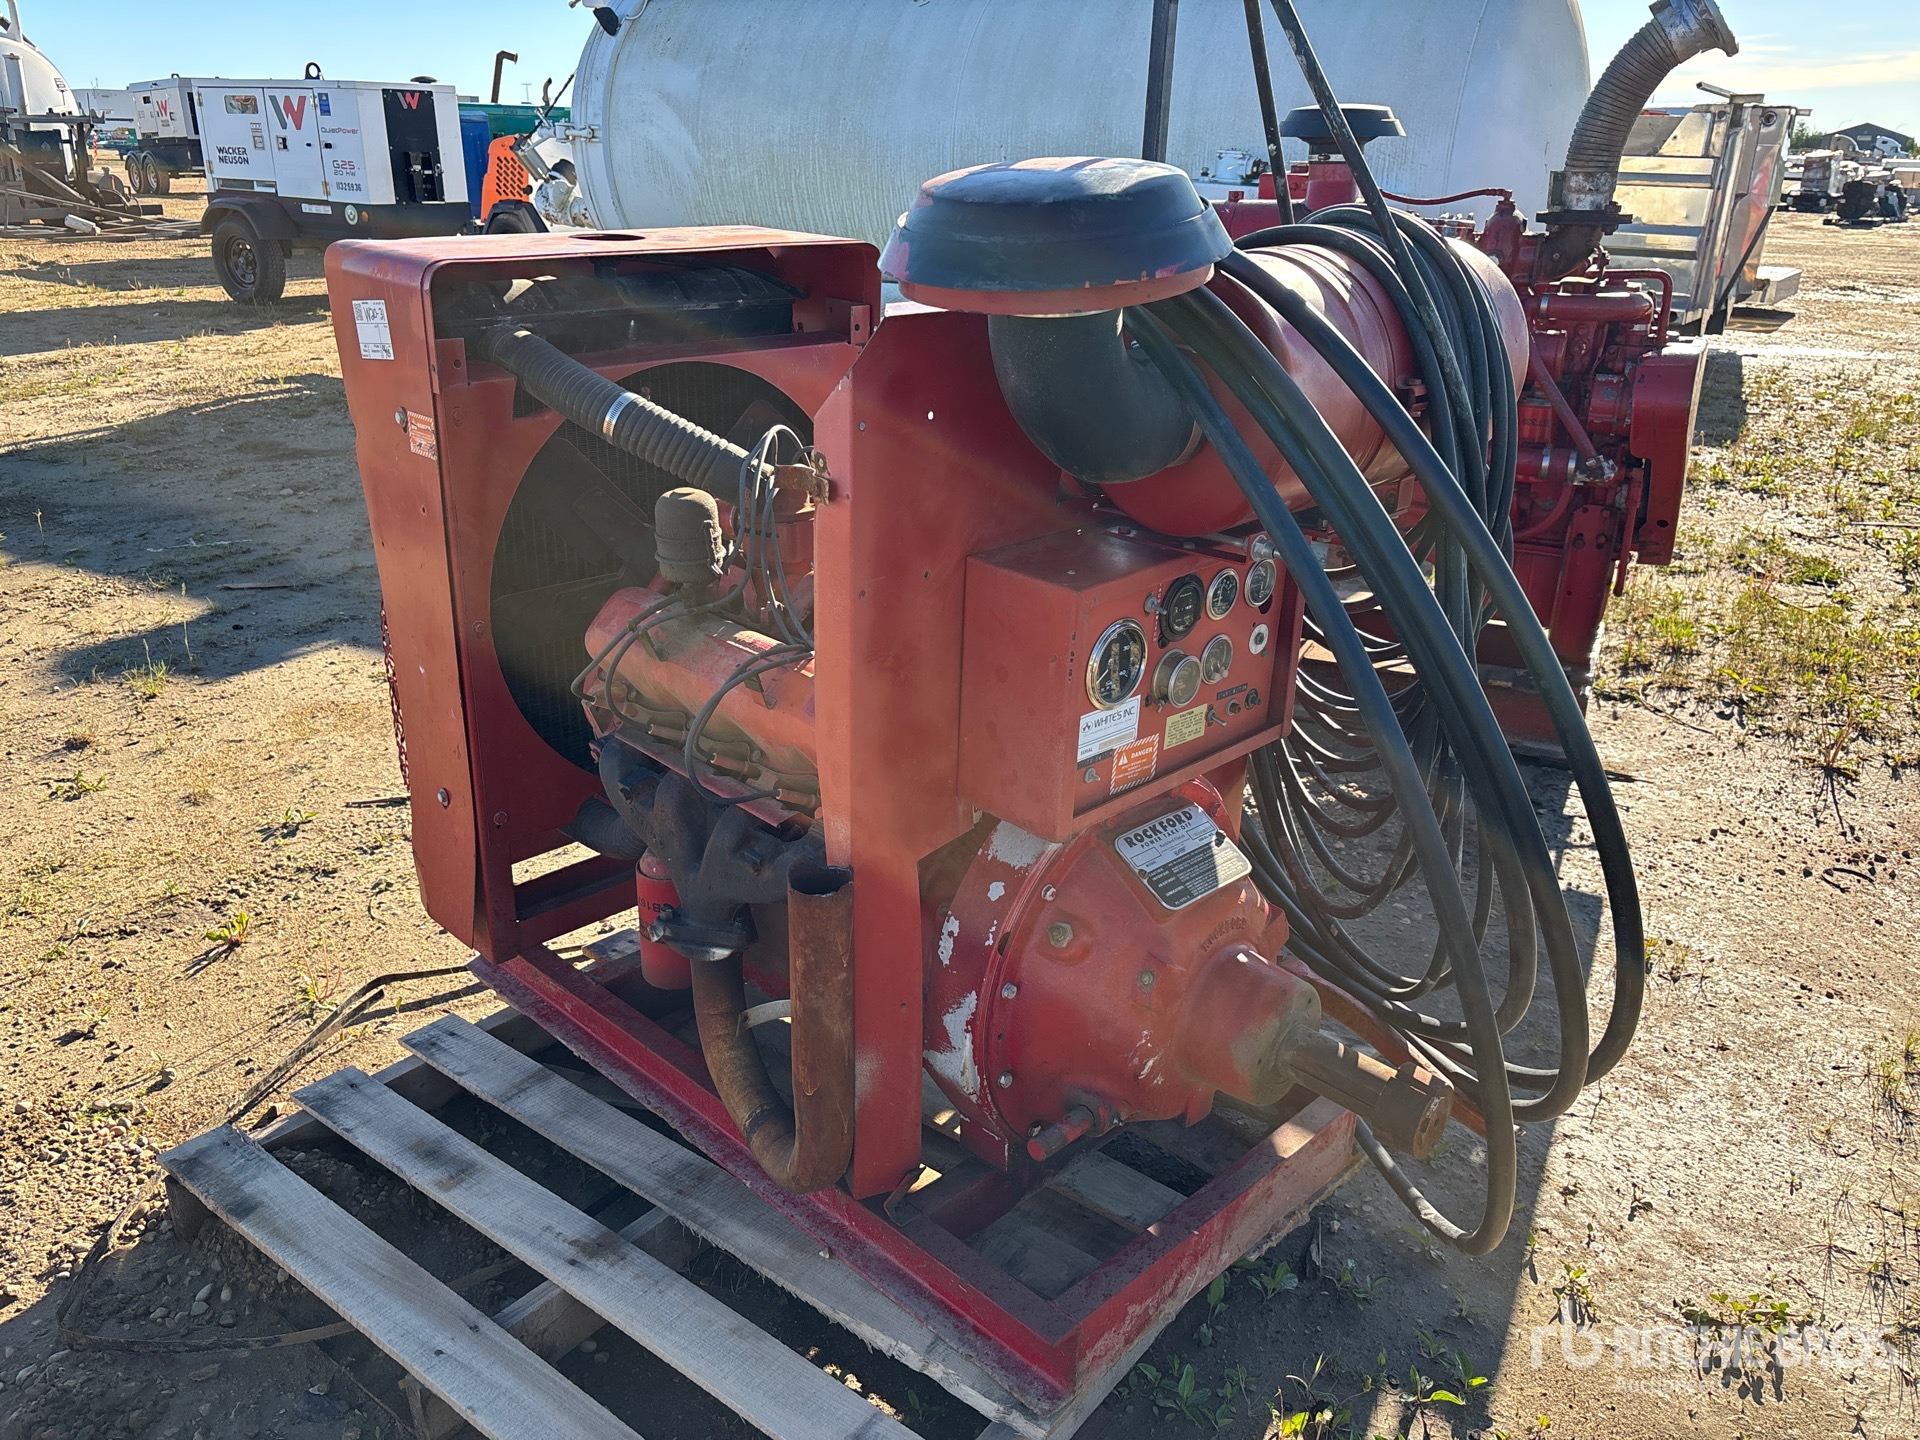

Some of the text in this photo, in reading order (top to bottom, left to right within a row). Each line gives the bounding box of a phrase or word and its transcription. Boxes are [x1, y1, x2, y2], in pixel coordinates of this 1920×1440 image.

[320, 126, 359, 135] QuietPower
[216, 145, 248, 156] WACKER
[218, 155, 250, 165] NEUSON
[332, 159, 356, 171] G25
[1094, 710, 1122, 728] WHITE'S
[1123, 705, 1135, 717] INC
[1131, 746, 1153, 759] DANGER
[1123, 810, 1193, 848] ROCKFORD
[1140, 836, 1160, 849] POWER
[1163, 822, 1192, 838] TAKE-OFF
